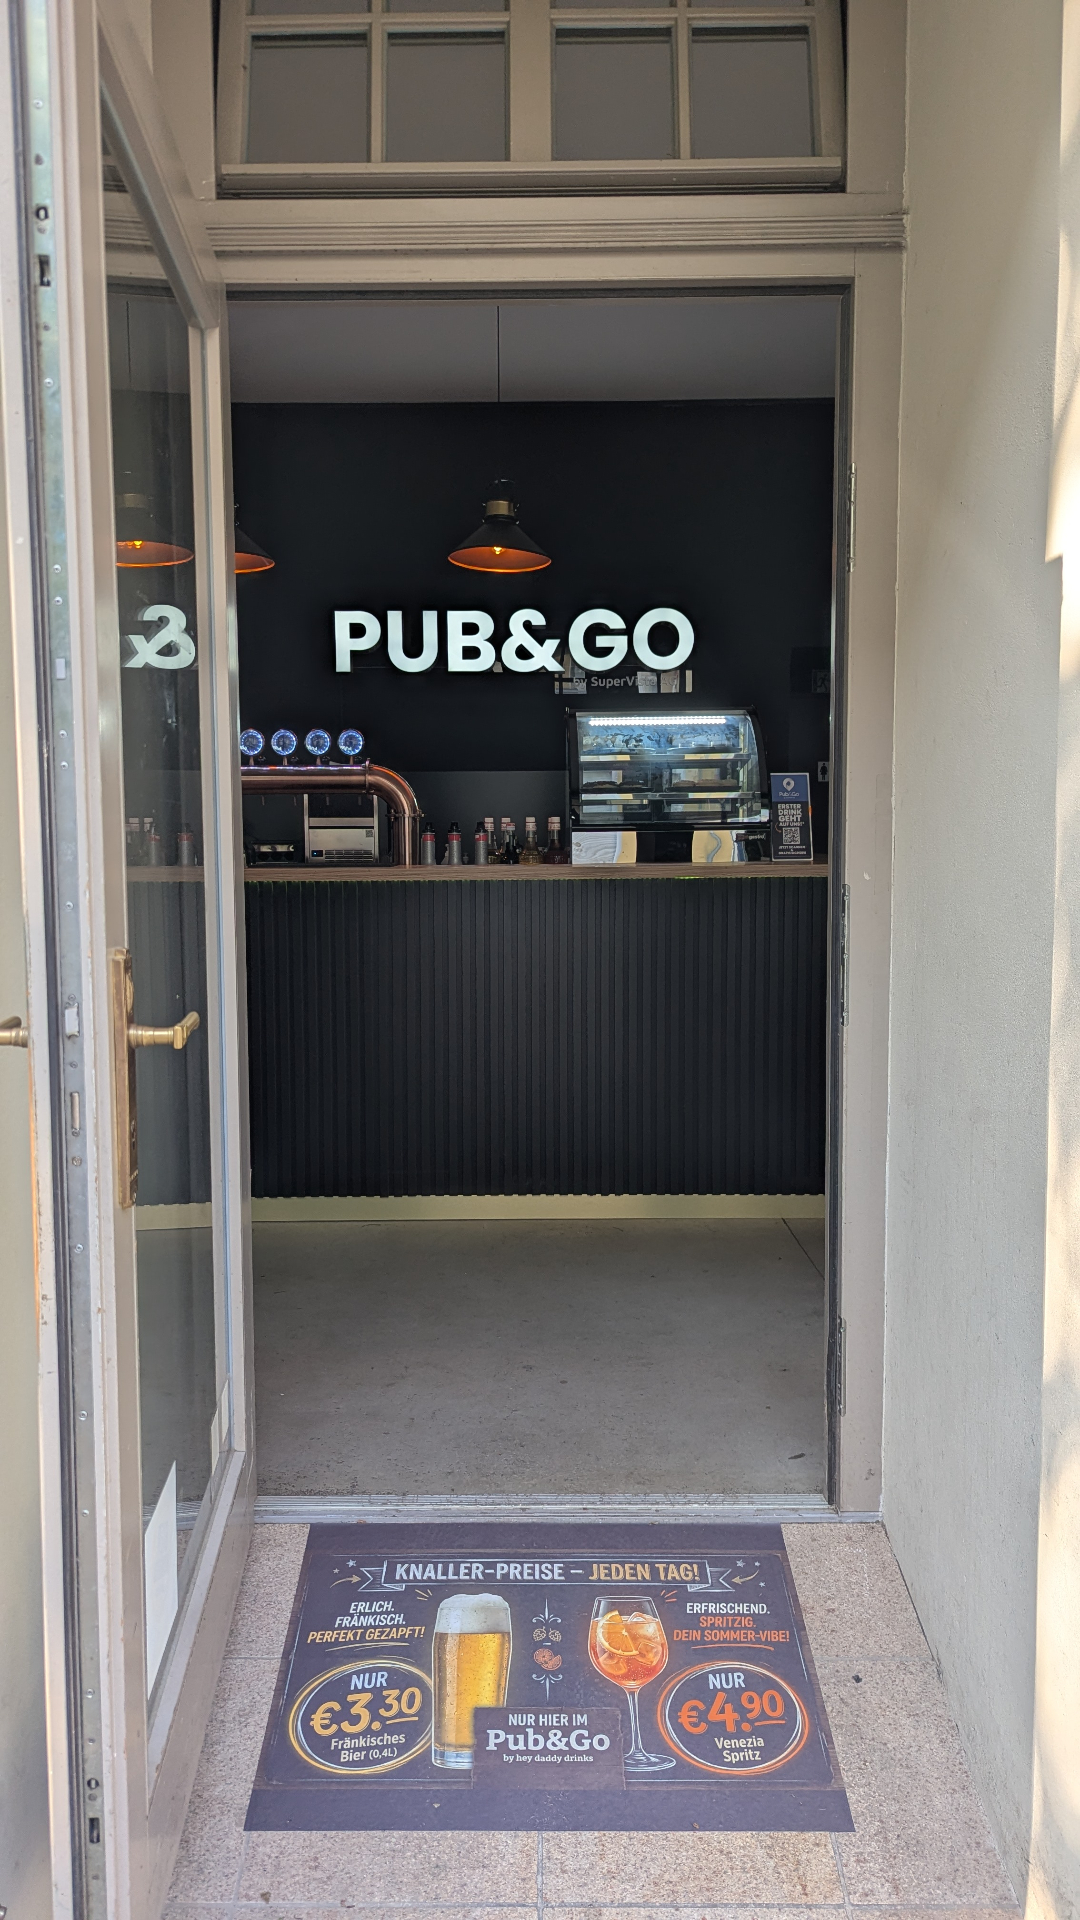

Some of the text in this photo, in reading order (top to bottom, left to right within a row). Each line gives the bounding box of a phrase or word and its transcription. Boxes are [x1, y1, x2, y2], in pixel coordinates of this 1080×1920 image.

[333, 607, 695, 673] PUB&GO
[573, 677, 587, 690] by
[590, 675, 657, 689] SuperVista
[395, 1563, 566, 1580] KNALLER-PREISE
[588, 1563, 651, 1581] JEDEN
[655, 1563, 701, 1581] TAG!
[349, 1600, 395, 1614] ERLICH.
[686, 1602, 770, 1614] ERFRISCHEND.
[334, 1613, 406, 1628] FRÄNKISCH.
[699, 1616, 757, 1628] SPRITZIG.
[307, 1626, 426, 1644] PERFEKT GEZAPFT!
[673, 1629, 790, 1642] DEIN SOMMER-VIBE!
[350, 1671, 388, 1691] NUR
[708, 1672, 746, 1690] NUR
[508, 1713, 588, 1726] NUR HIER IM
[330, 1733, 406, 1750] Fränkisches
[485, 1727, 611, 1751] Pub&Go
[714, 1736, 765, 1749] Venezia
[340, 1747, 398, 1763] Bier (0,4L)
[503, 1753, 594, 1764] by hey daddy drinks
[722, 1749, 762, 1764] Spritz
